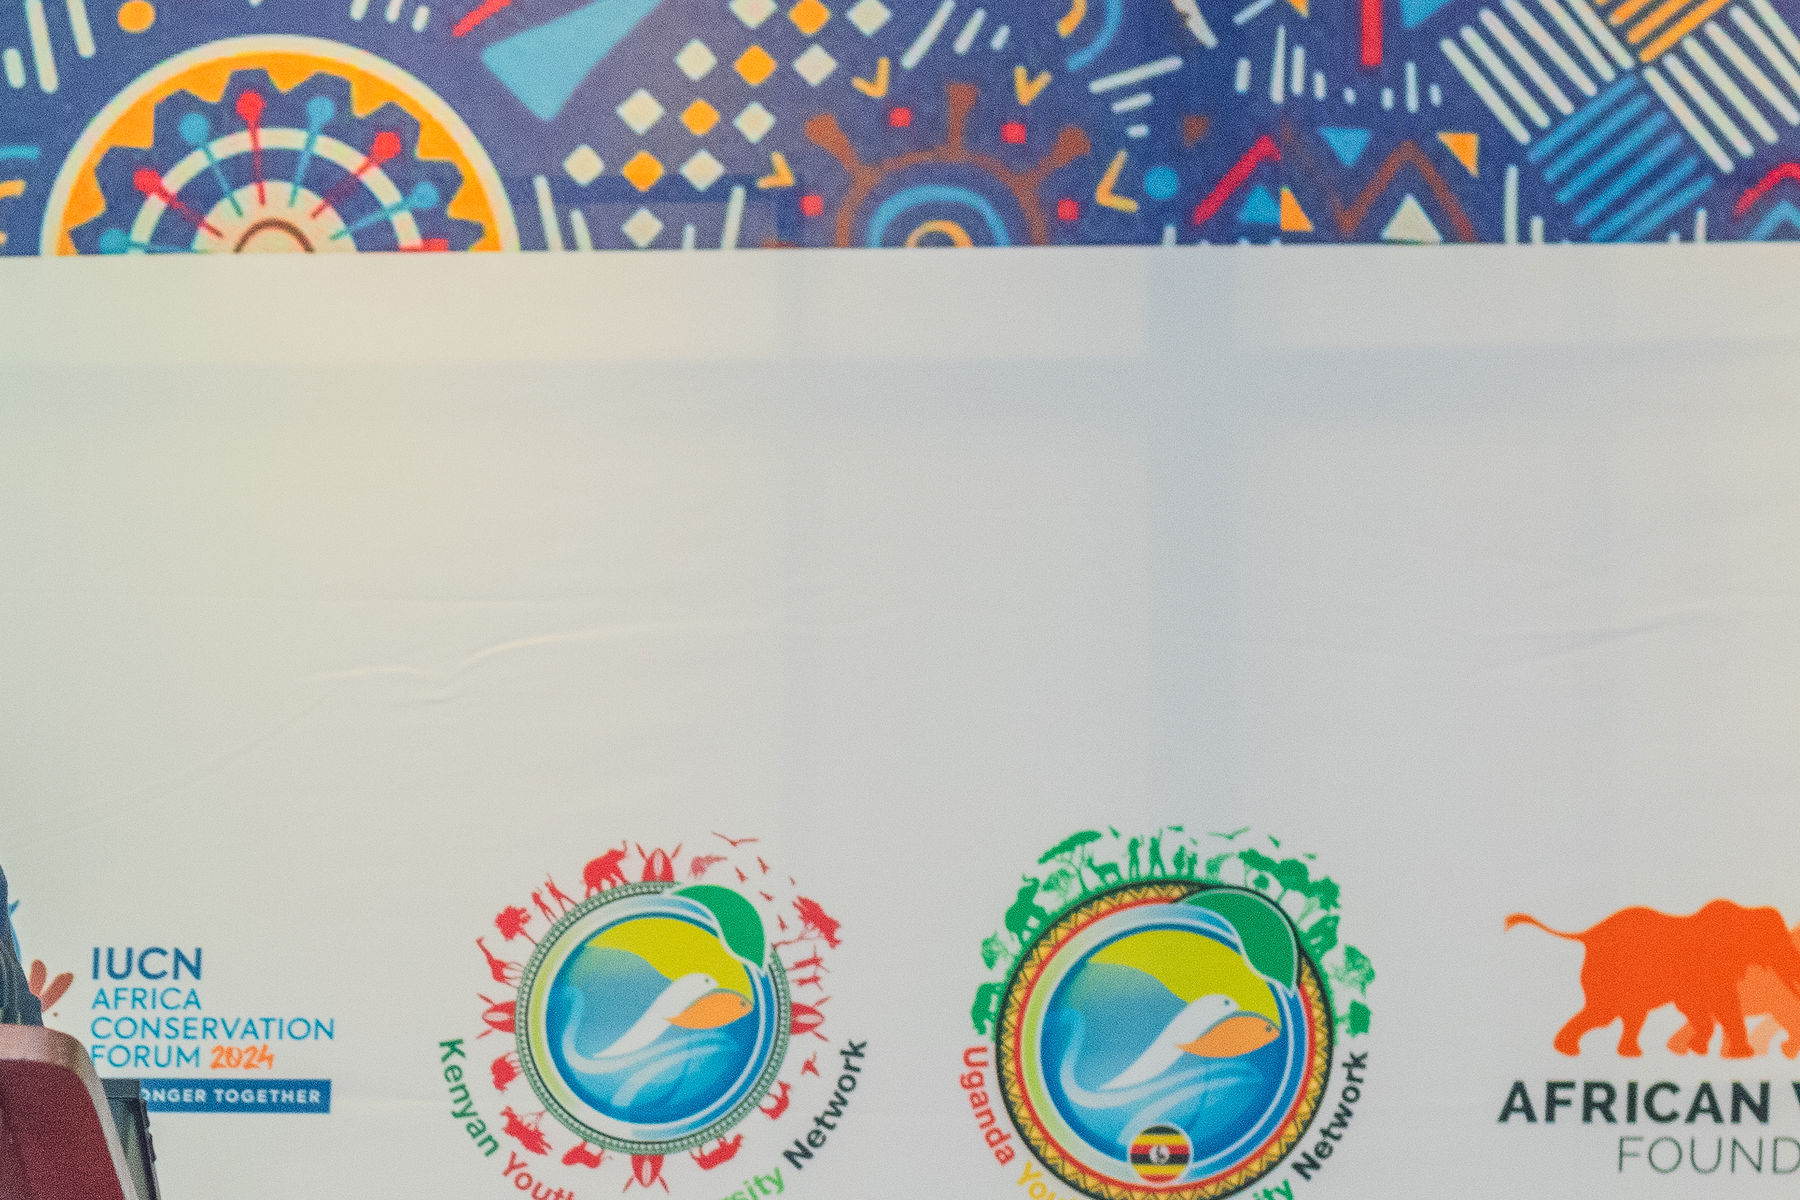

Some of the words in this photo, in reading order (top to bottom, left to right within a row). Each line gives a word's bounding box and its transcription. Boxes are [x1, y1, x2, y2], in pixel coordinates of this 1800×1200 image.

[93, 947, 202, 980] IUCN
[92, 987, 201, 1010] AFRICA
[91, 1016, 334, 1041] CONSERVATION
[92, 1043, 201, 1070] FORUM
[211, 1044, 274, 1069] 2024
[212, 1087, 324, 1105] TOGETHER
[439, 1034, 502, 1156] Kenyan
[780, 1036, 866, 1170] Network
[1499, 1081, 1769, 1123] AFRICAN
[960, 1045, 1016, 1167] Uganda
[1290, 1048, 1367, 1180] Network
